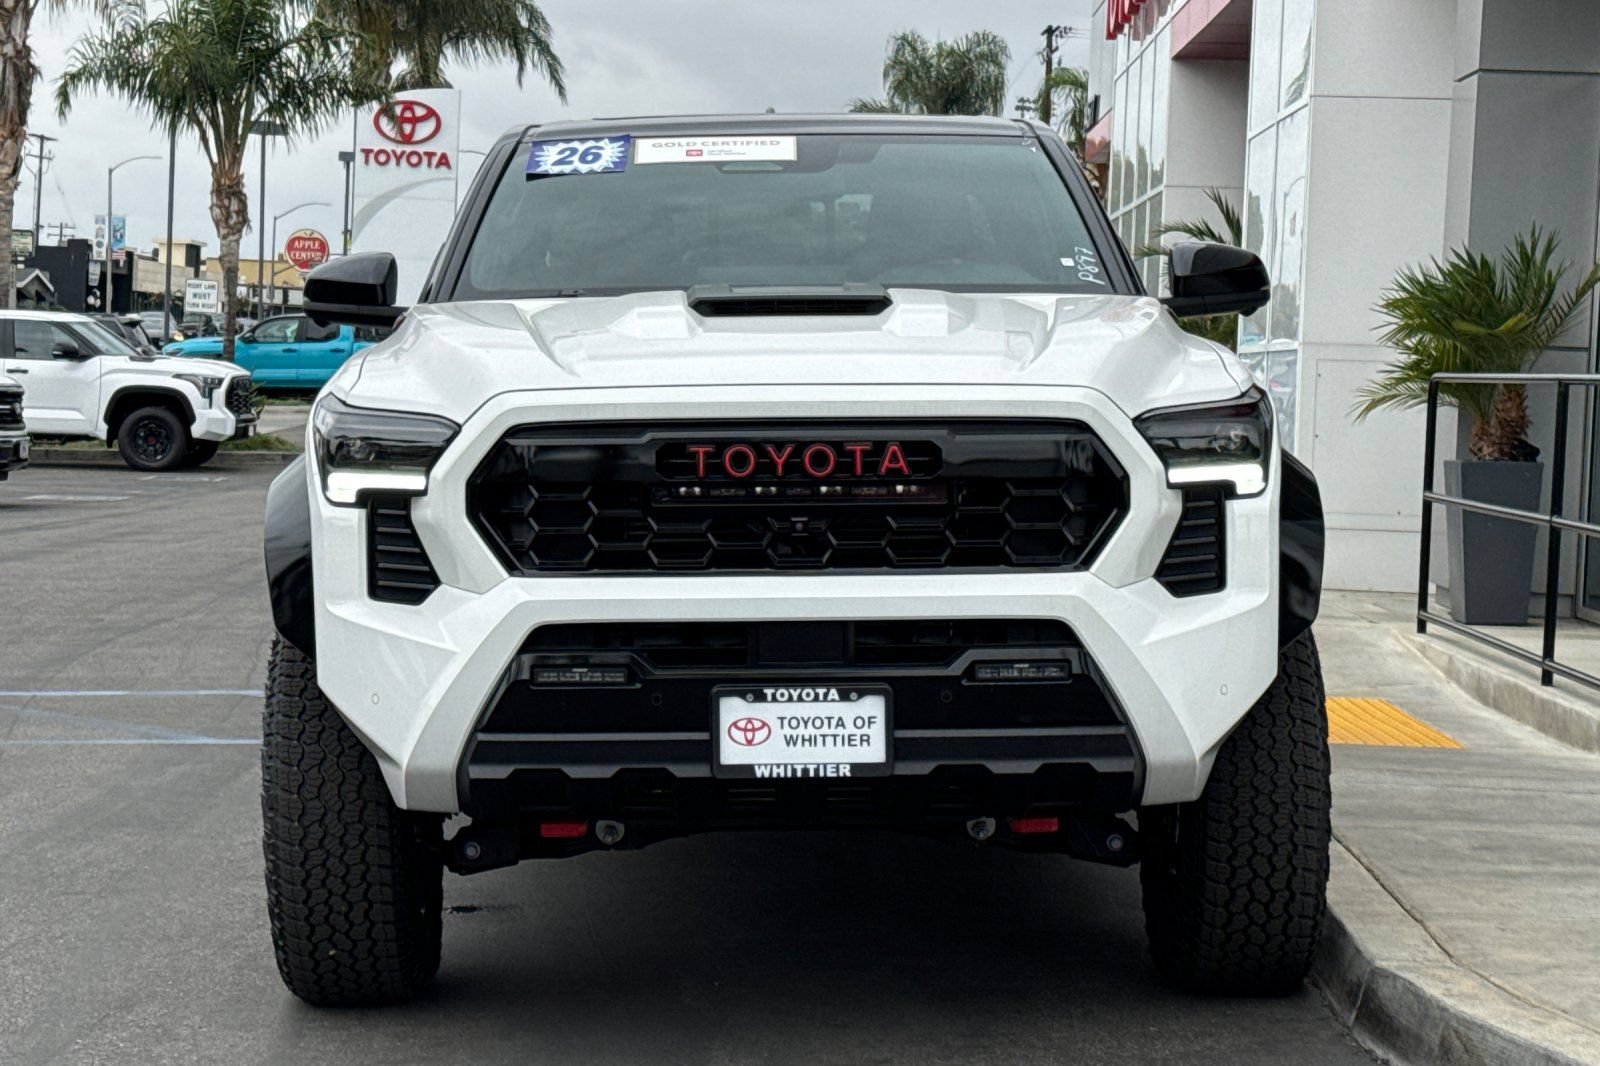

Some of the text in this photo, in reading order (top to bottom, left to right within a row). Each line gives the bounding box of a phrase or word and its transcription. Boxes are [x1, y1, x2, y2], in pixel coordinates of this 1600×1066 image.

[360, 148, 452, 170] TOYOTA
[550, 146, 605, 166] 26
[293, 240, 321, 249] APPLE
[192, 292, 211, 300] MUST
[686, 442, 911, 478] TOYOTA
[763, 688, 840, 702] TOYOTA
[777, 715, 878, 730] TOYOTA OF
[783, 734, 871, 748] WHITTIER
[754, 763, 851, 778] WHITTIER
